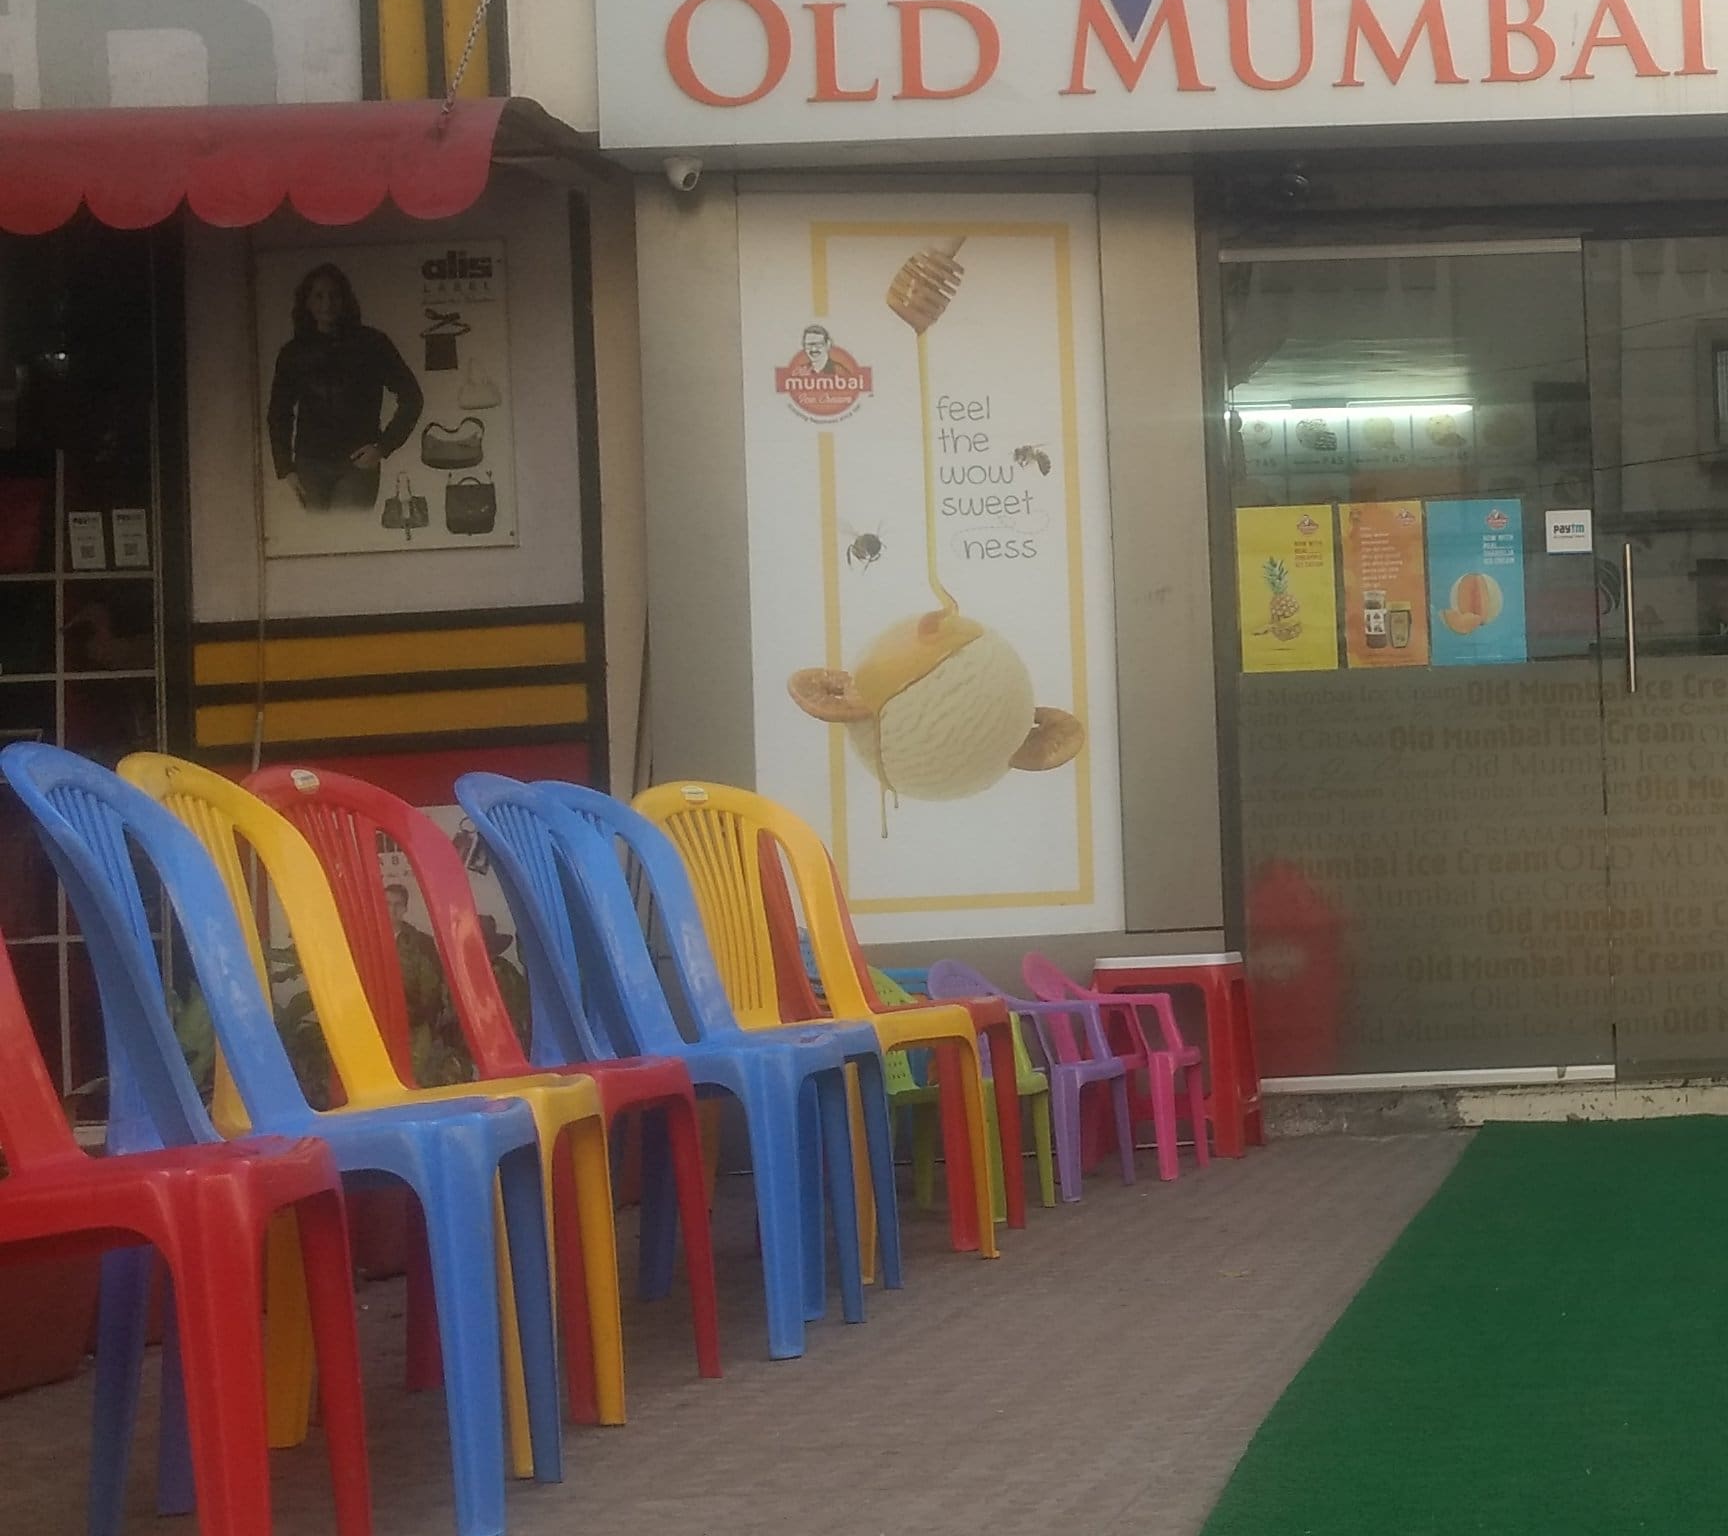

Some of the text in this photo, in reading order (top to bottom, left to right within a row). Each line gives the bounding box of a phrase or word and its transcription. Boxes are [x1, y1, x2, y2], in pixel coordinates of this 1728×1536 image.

[936, 394, 993, 423] feel
[937, 427, 990, 454] the
[939, 462, 1016, 486] wow
[941, 491, 1035, 518] sweet
[1553, 523, 1585, 535] paytm
[962, 535, 1038, 560] ness
[1388, 718, 1694, 752] Old Mumbai Ice Cream
[1636, 773, 1679, 802] Old
[1407, 849, 1448, 877] Ice
[1457, 846, 1550, 876] Cream
[1486, 906, 1534, 935] Old
[1662, 901, 1704, 928] Ice
[1406, 952, 1454, 984] Old
[1462, 948, 1574, 982] Mumbai
[1632, 945, 1725, 975] Cream
[1664, 1005, 1710, 1034] Old
